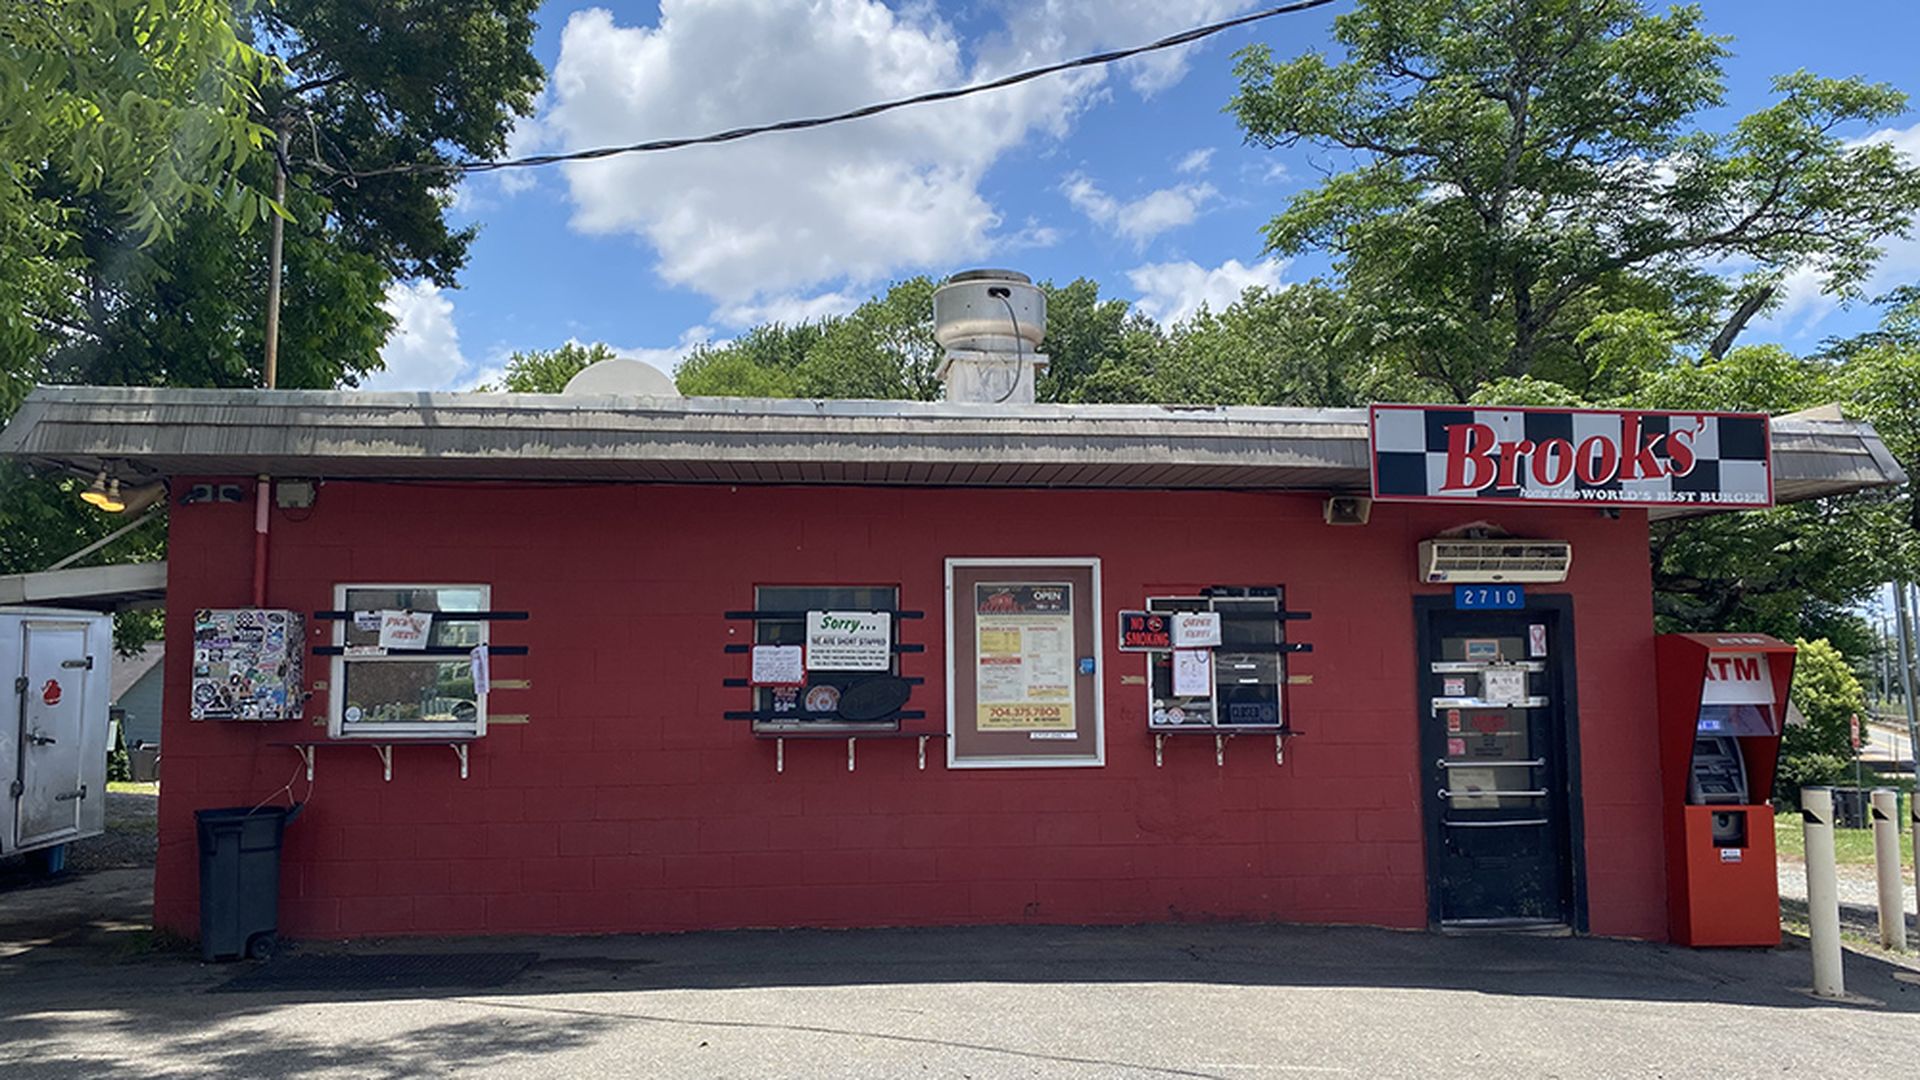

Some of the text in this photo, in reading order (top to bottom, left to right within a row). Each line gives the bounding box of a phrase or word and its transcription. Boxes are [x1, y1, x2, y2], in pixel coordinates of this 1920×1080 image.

[1440, 414, 1705, 492] Brooks'
[1581, 489, 1652, 501] WORLD'S
[1656, 491, 1696, 502] BEST
[1699, 491, 1766, 503] BURGER
[1033, 591, 1062, 601] OPEN
[1464, 590, 1516, 604] 2710
[820, 615, 877, 634] Sorry...
[1130, 617, 1143, 630] NO
[1126, 632, 1169, 646] SMOKING
